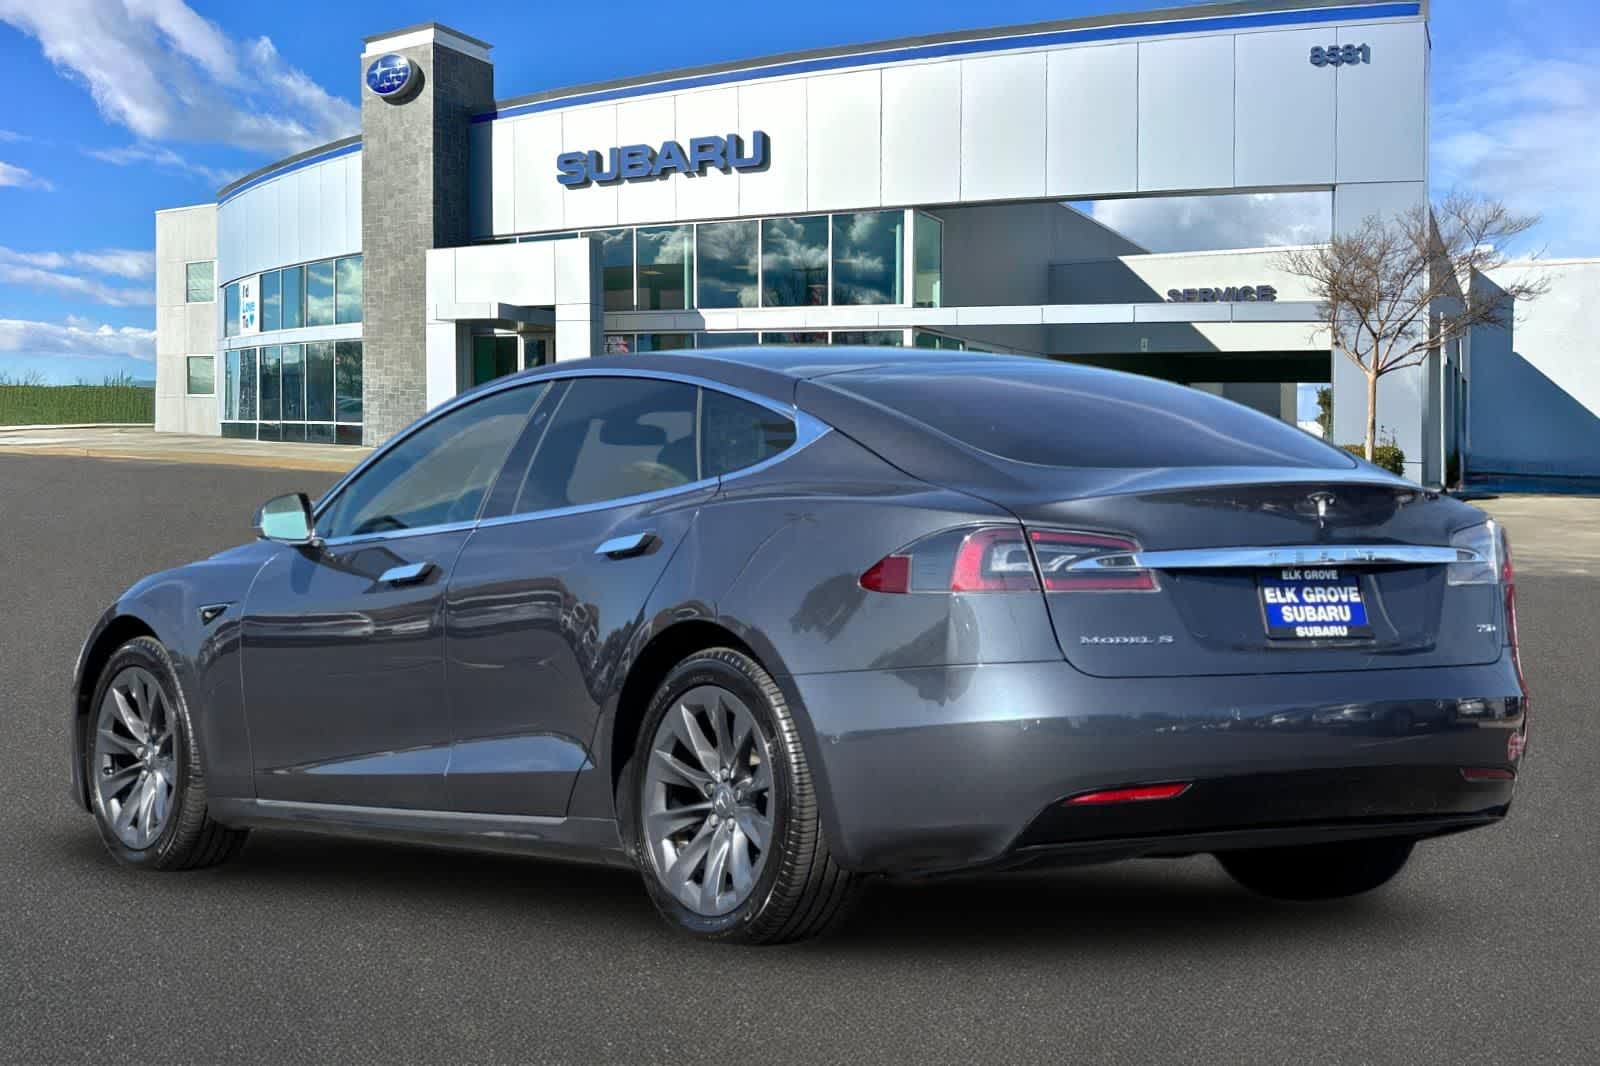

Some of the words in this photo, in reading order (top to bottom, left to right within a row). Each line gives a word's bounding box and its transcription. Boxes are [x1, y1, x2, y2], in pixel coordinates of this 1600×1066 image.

[556, 130, 771, 190] SUBARU
[1167, 285, 1277, 303] SERVICE
[1282, 570, 1301, 580] ELK
[1304, 570, 1338, 580] GROVE
[1264, 587, 1299, 603] ELK
[1302, 586, 1361, 603] GROVE
[1281, 605, 1352, 622] SUBARU
[1296, 626, 1348, 637] SUBARU
